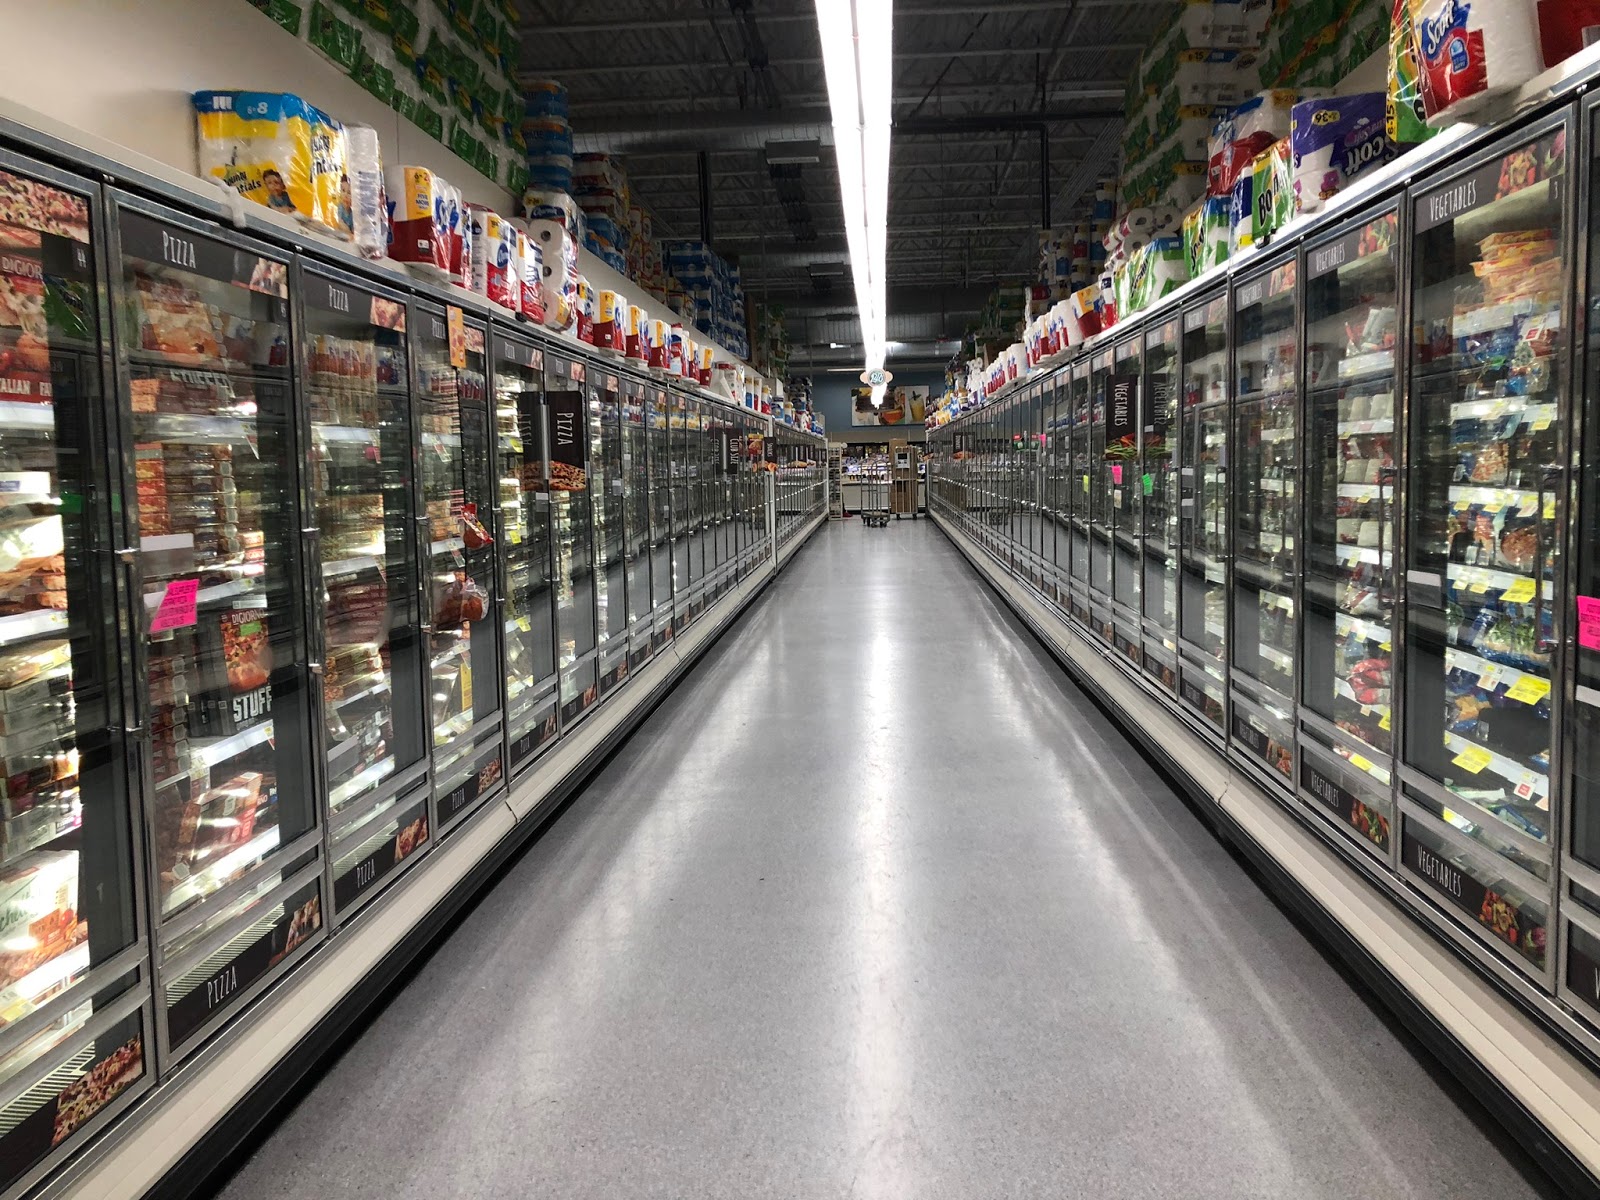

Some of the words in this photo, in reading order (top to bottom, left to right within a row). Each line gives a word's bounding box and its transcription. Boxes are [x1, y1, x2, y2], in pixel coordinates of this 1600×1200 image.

[1429, 178, 1477, 223] VEGETABLES
[162, 230, 197, 269] PIZZA
[1315, 241, 1345, 273] VEGETABLES
[328, 284, 349, 313] PIZZA
[1114, 382, 1130, 427] VEGETABLES
[557, 412, 575, 446] PIZZA
[1310, 769, 1340, 810] VEGETABLES
[356, 857, 376, 889] PIZZA
[1417, 844, 1463, 899] VEGETABLES
[207, 965, 237, 1009] PIZZA
